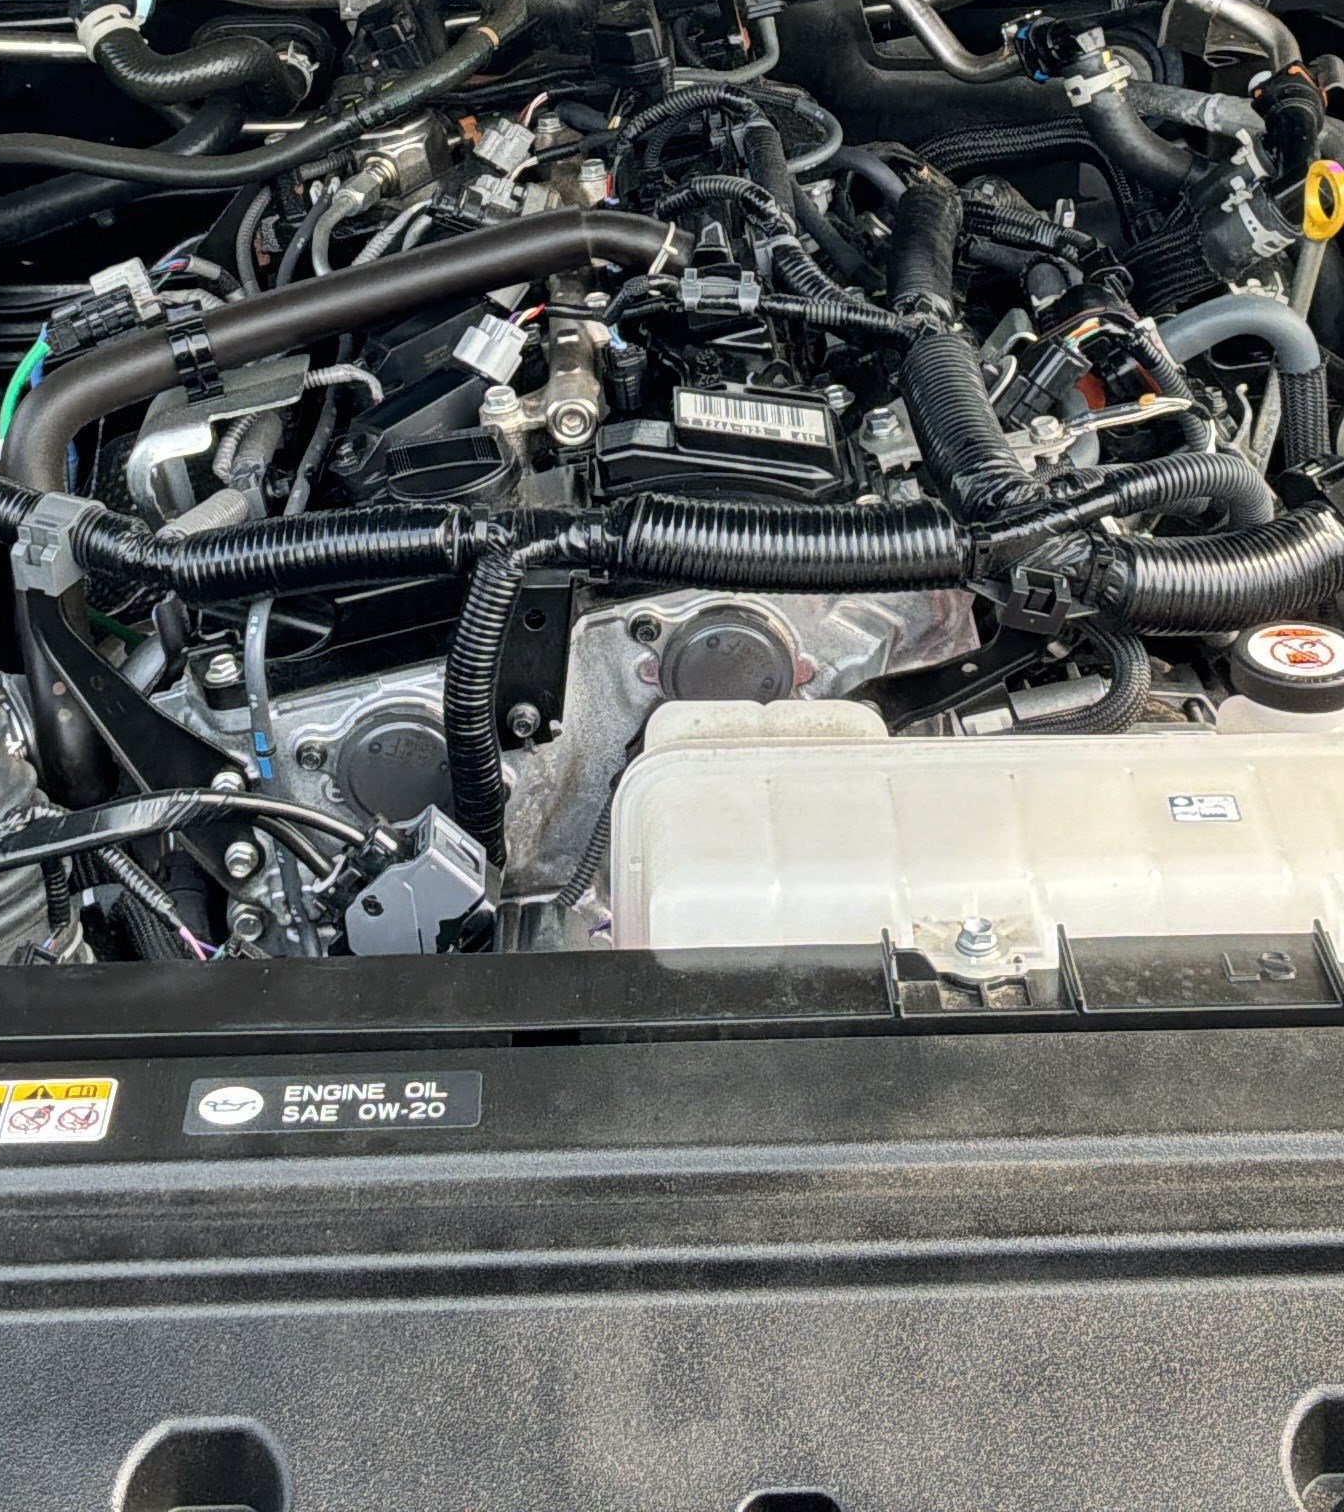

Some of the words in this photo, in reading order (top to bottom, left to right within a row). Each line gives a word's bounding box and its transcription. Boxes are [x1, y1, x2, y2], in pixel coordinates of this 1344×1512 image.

[283, 1082, 387, 1102] ENGINE
[404, 1081, 449, 1100] OIL
[281, 1103, 341, 1124] SAE
[358, 1101, 447, 1122] 0W-20
